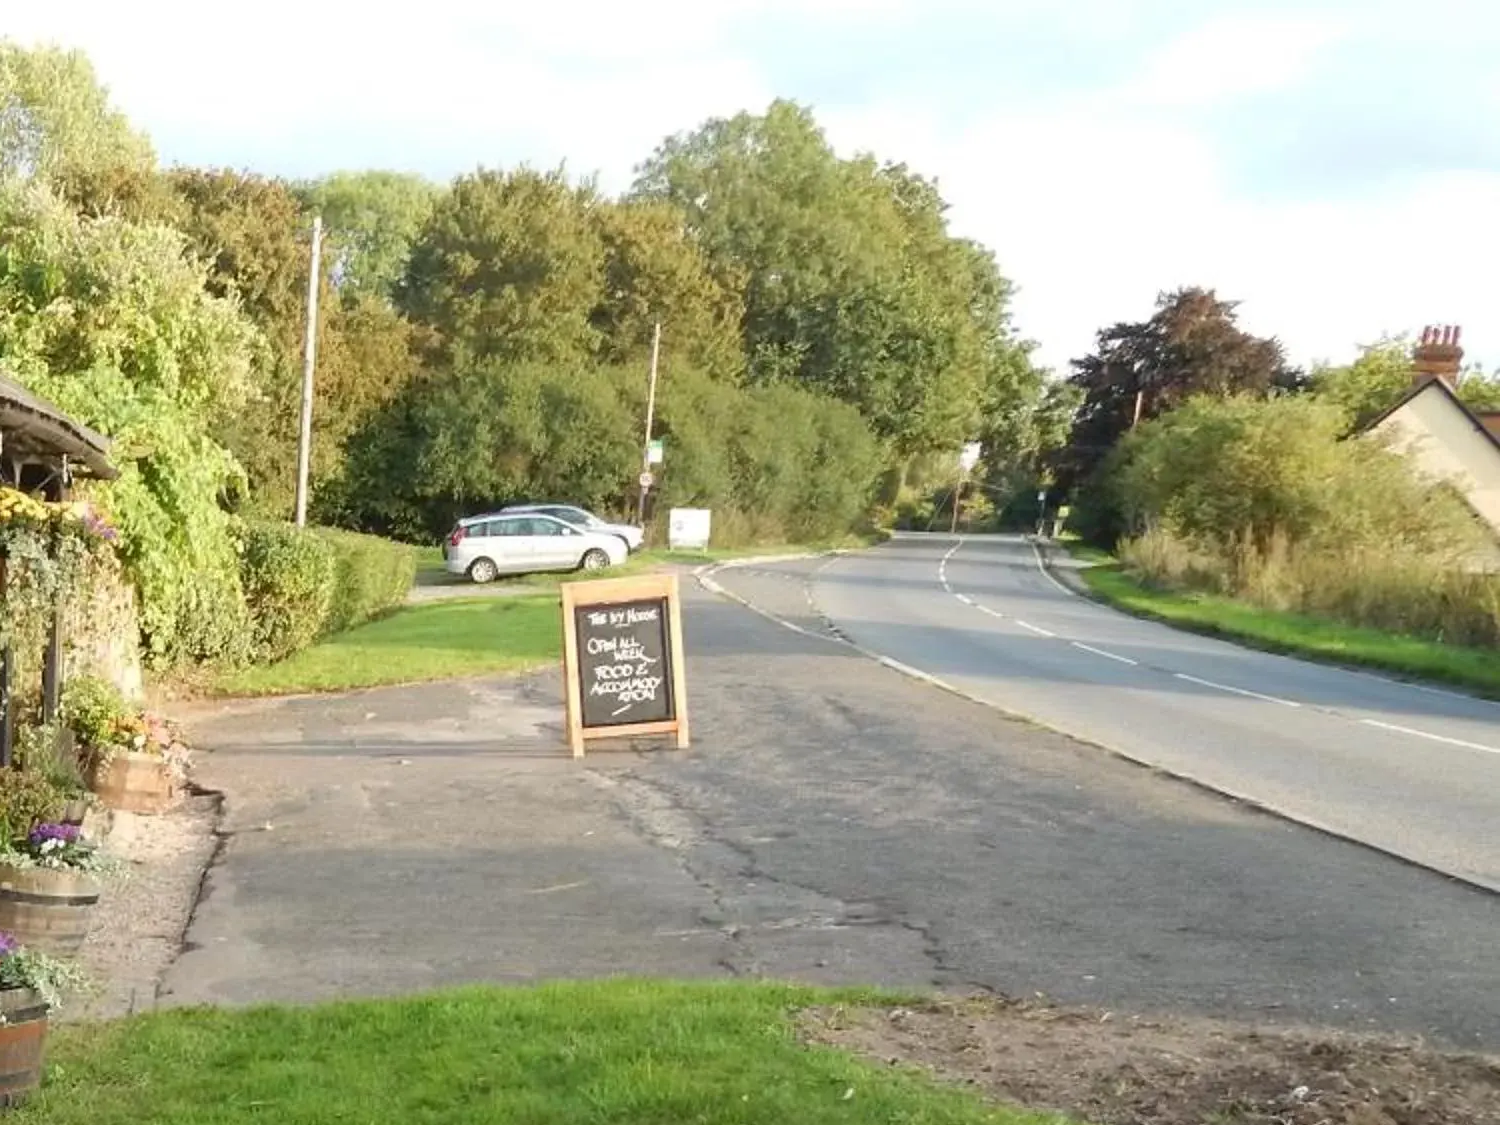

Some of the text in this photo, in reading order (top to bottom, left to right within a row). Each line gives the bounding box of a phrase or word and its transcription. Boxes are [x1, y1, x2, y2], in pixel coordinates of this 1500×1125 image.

[587, 636, 640, 655] OPEN ALL
[614, 646, 654, 662] WEEK
[594, 664, 633, 679] FOOD
